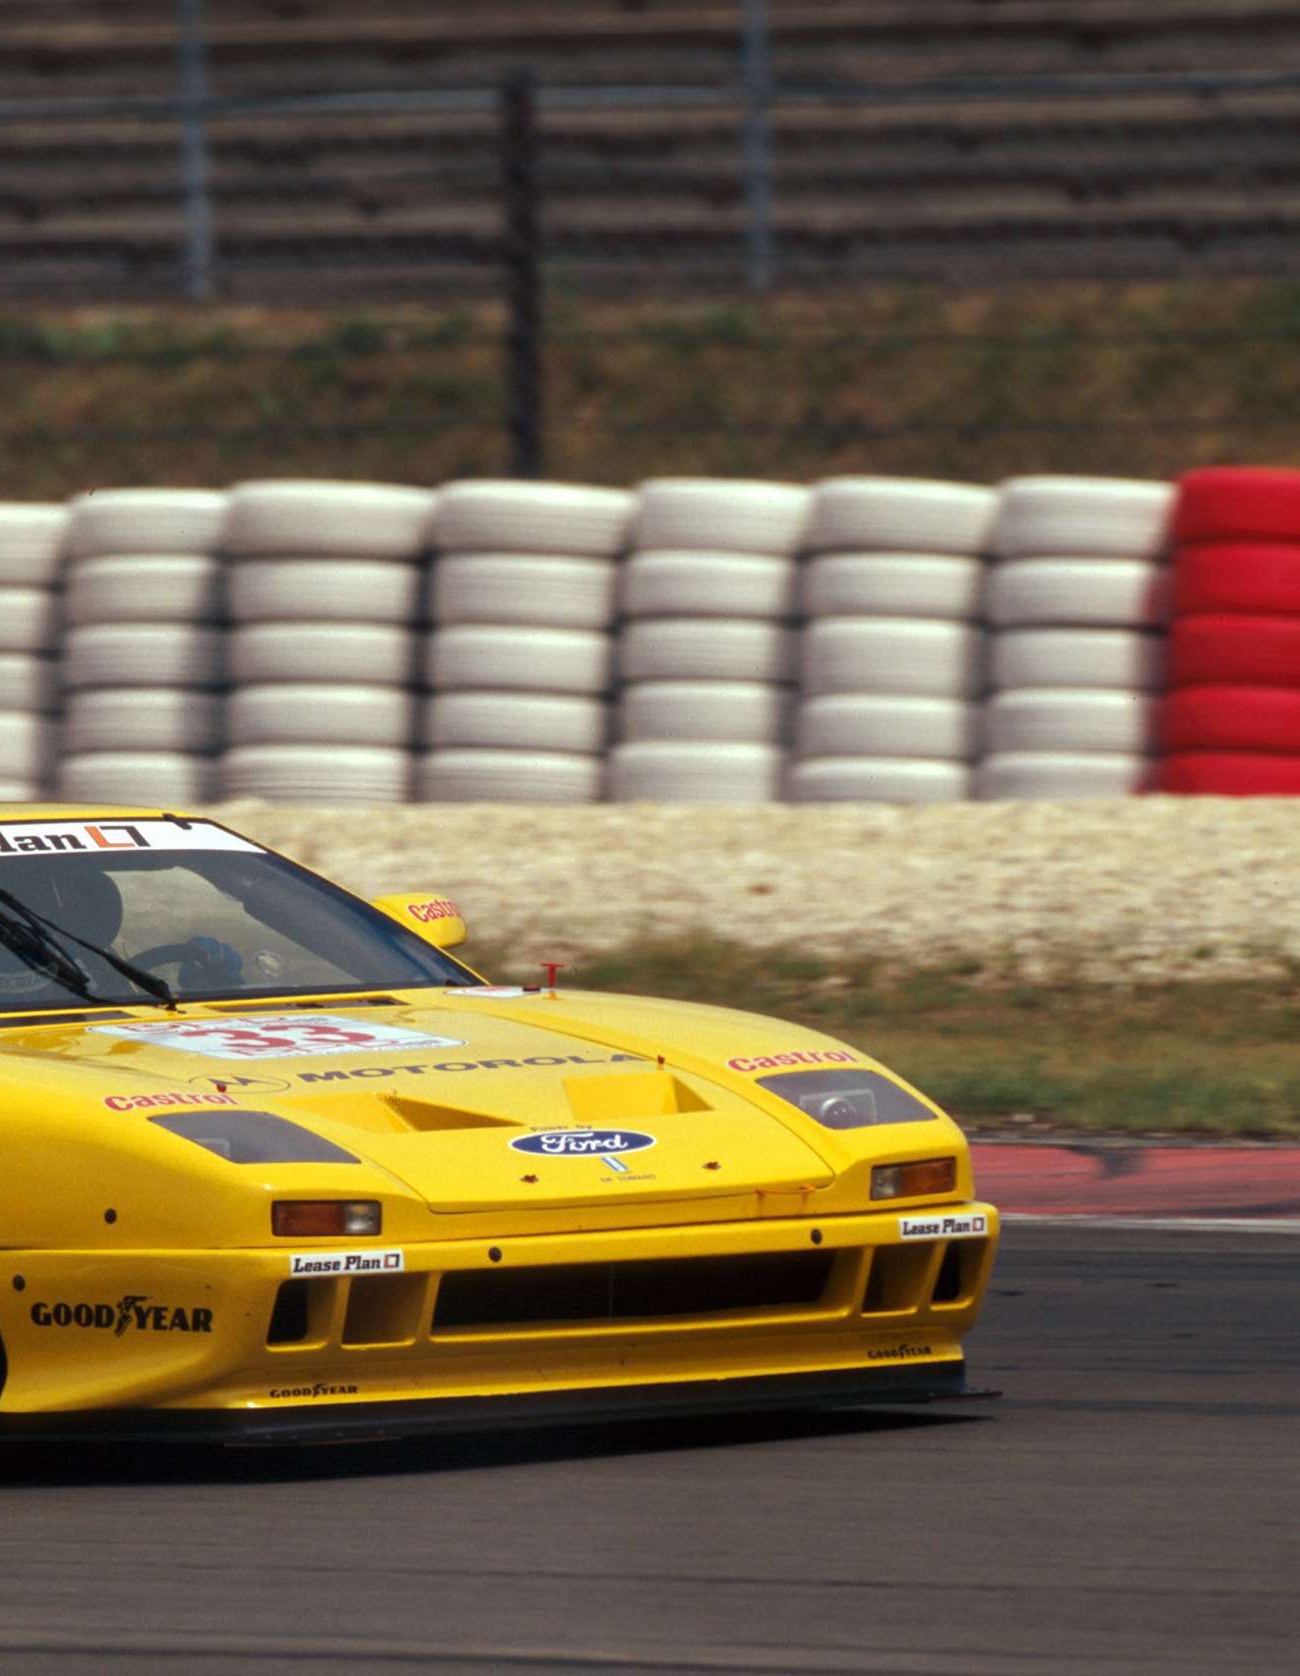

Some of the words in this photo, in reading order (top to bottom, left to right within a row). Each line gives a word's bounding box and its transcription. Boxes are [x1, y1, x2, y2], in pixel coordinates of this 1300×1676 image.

[178, 1024, 376, 1048] 33
[296, 1054, 646, 1083] MOTOROLA
[727, 1050, 858, 1072] Castrol
[104, 1092, 239, 1112] Castrol
[540, 1131, 629, 1153] Ford
[942, 1218, 970, 1233] Plan
[293, 1257, 341, 1273] Lease
[344, 1255, 382, 1271] Plan
[30, 1295, 213, 1337] GOODYEAR
[269, 1383, 359, 1398] GOODYEAR
